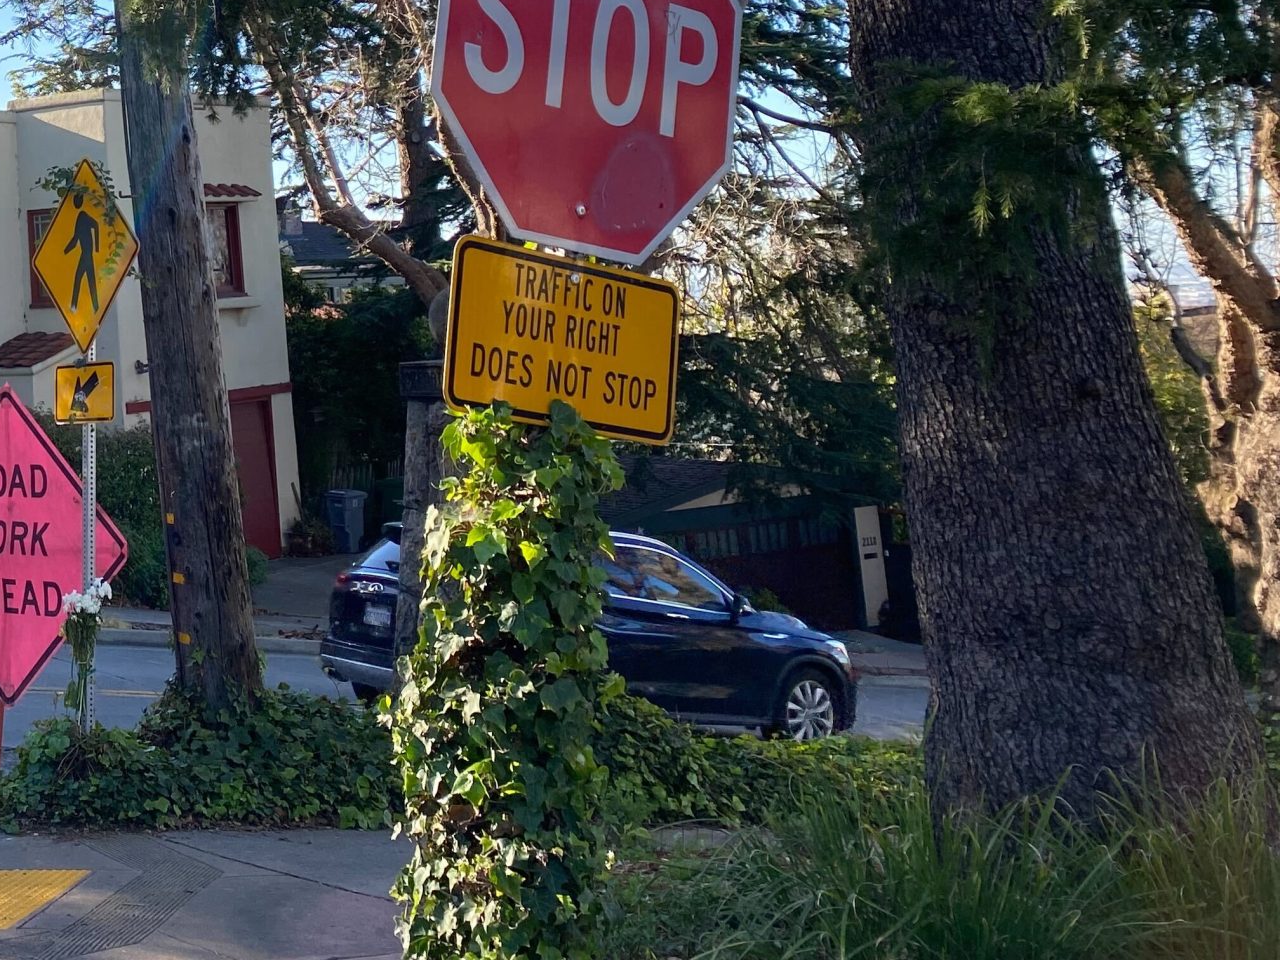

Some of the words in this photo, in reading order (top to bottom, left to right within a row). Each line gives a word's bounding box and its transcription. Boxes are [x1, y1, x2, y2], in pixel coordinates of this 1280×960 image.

[515, 263, 595, 312] TRAFFIC
[602, 283, 627, 319] ON
[503, 300, 556, 344] YOUR
[565, 315, 621, 356] RIGHT
[470, 342, 533, 388] DOES
[546, 359, 592, 399] NOT
[603, 371, 657, 411] STOP
